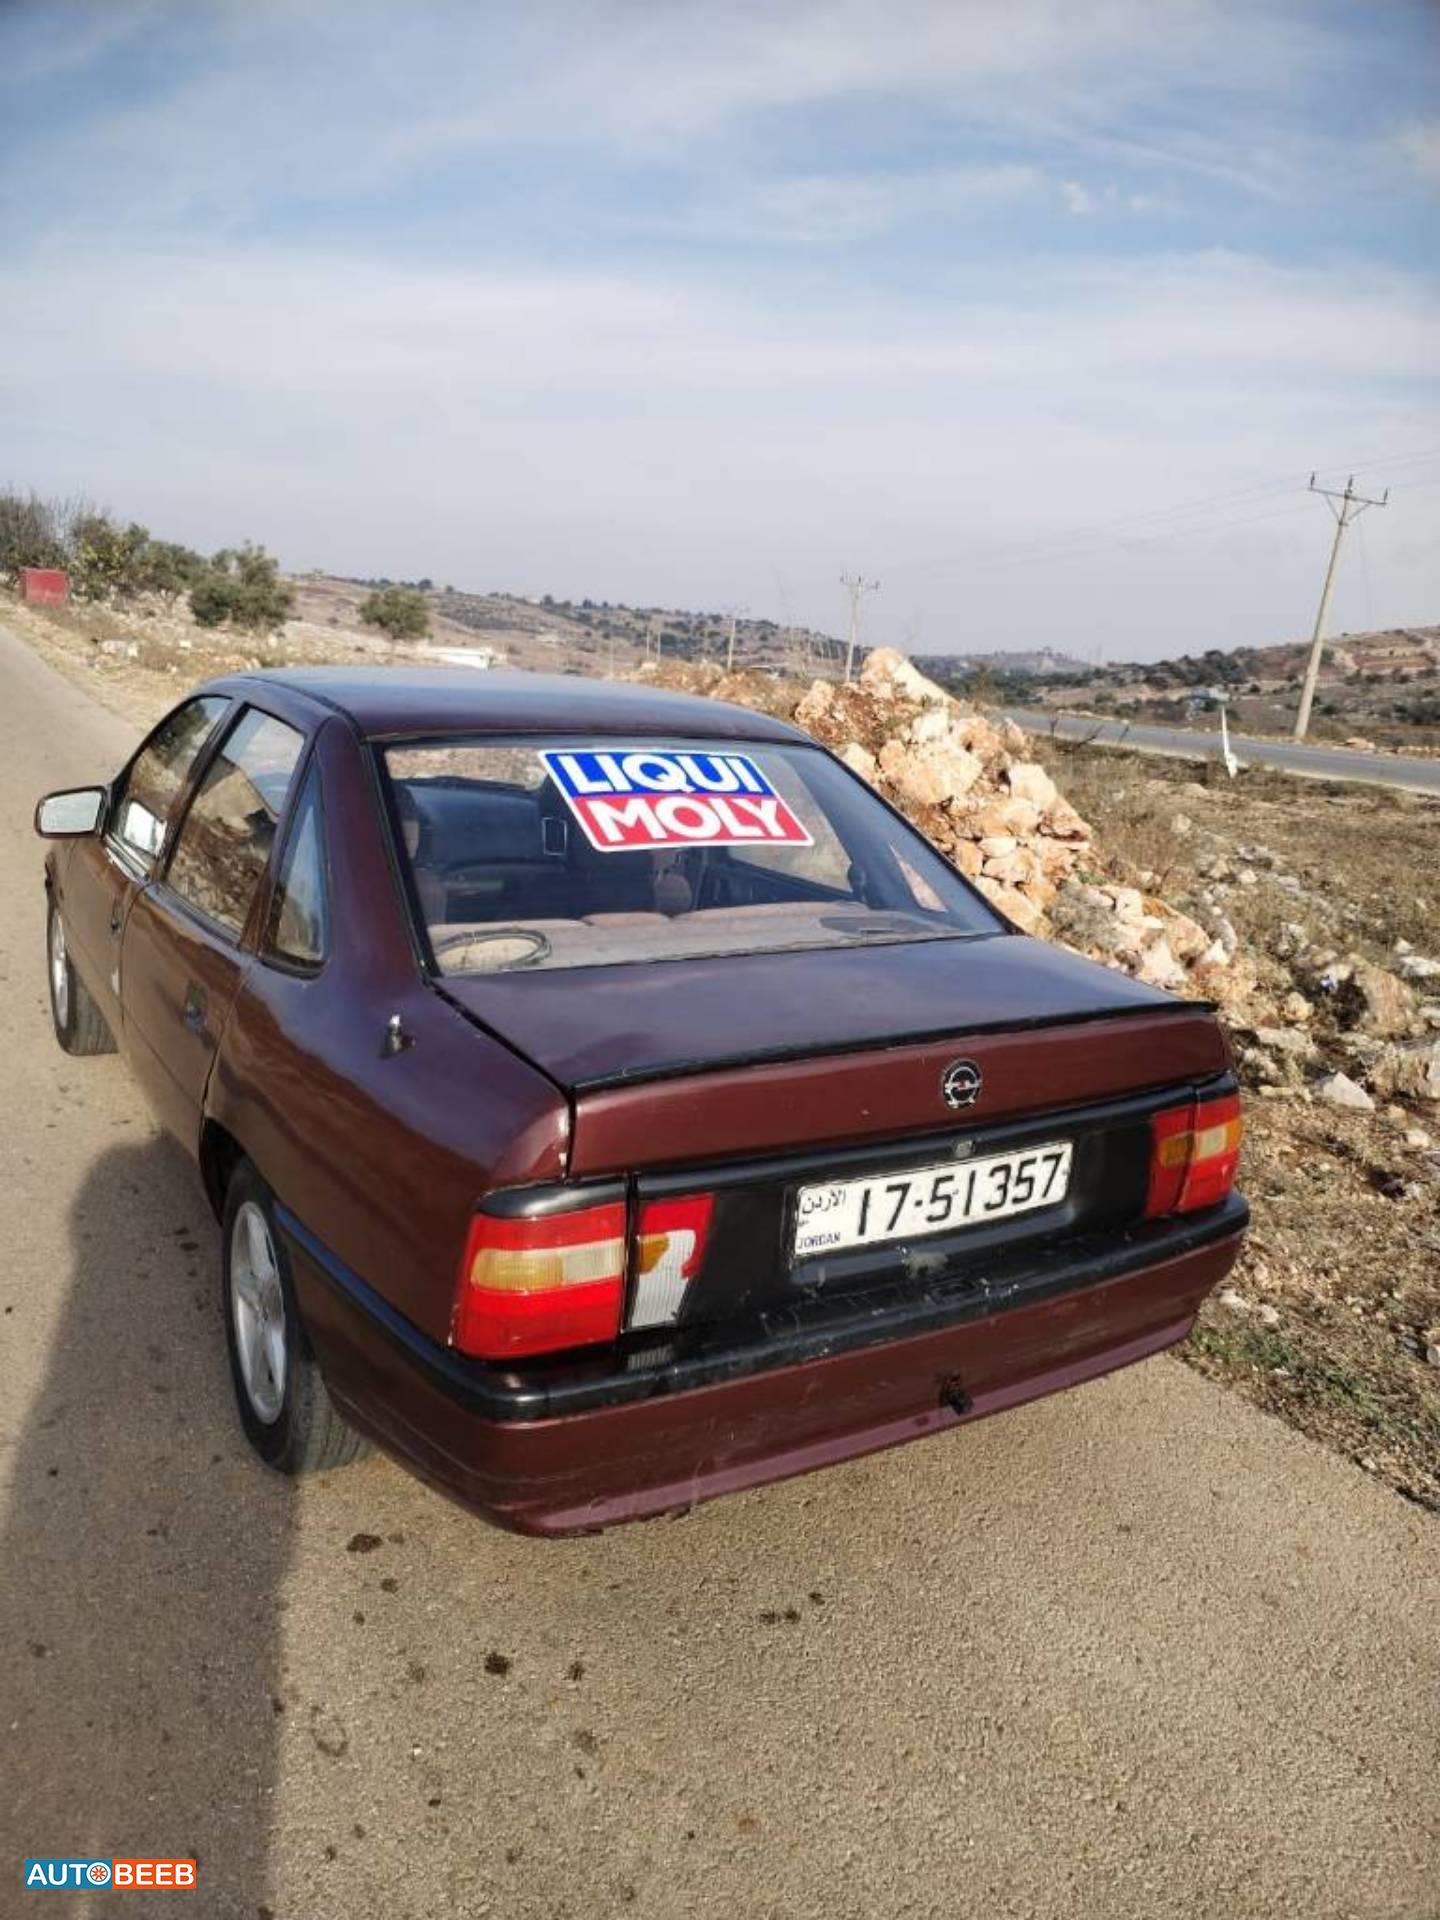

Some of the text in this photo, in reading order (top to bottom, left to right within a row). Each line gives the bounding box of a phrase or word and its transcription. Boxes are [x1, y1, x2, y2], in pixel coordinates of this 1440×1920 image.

[556, 754, 764, 794] LIQUI
[585, 797, 787, 843] MOLY
[797, 1231, 841, 1249] JORDAN
